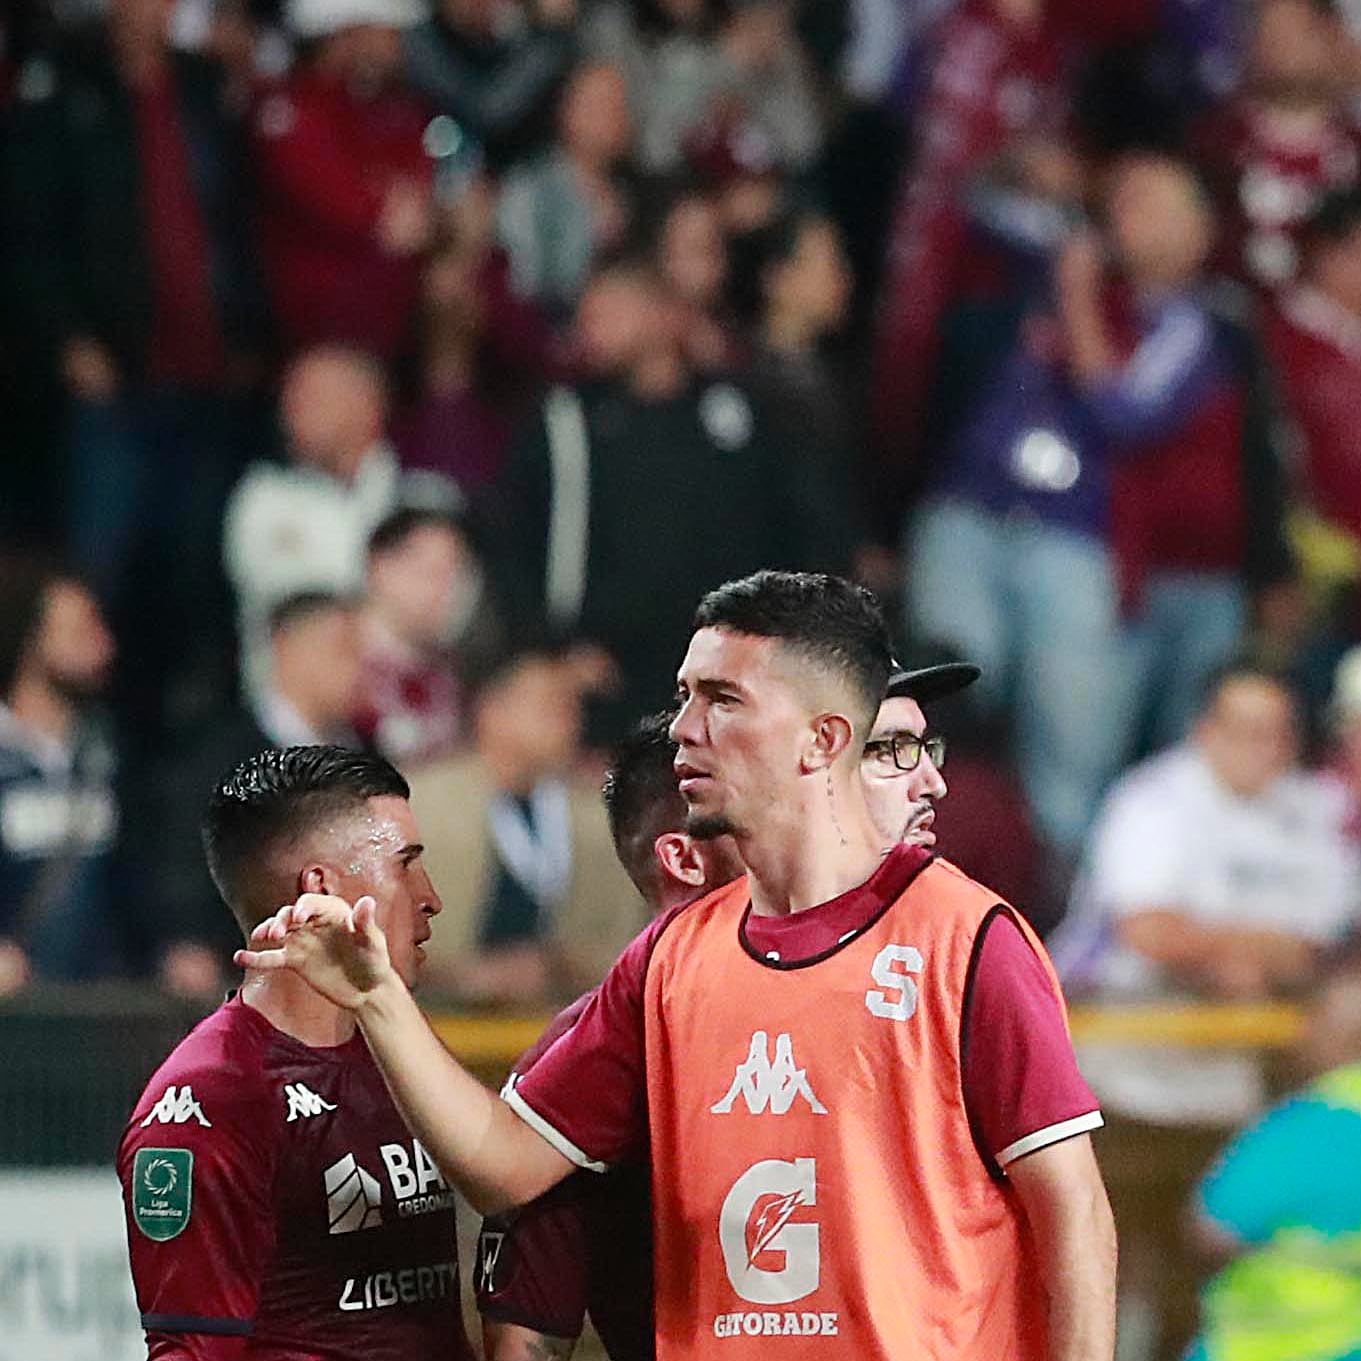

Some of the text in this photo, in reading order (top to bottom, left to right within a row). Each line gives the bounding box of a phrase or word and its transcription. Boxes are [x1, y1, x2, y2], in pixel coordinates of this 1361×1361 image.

[865, 943, 924, 1022] S
[379, 1137, 449, 1200] BA
[713, 1311, 840, 1338] GTORADE
